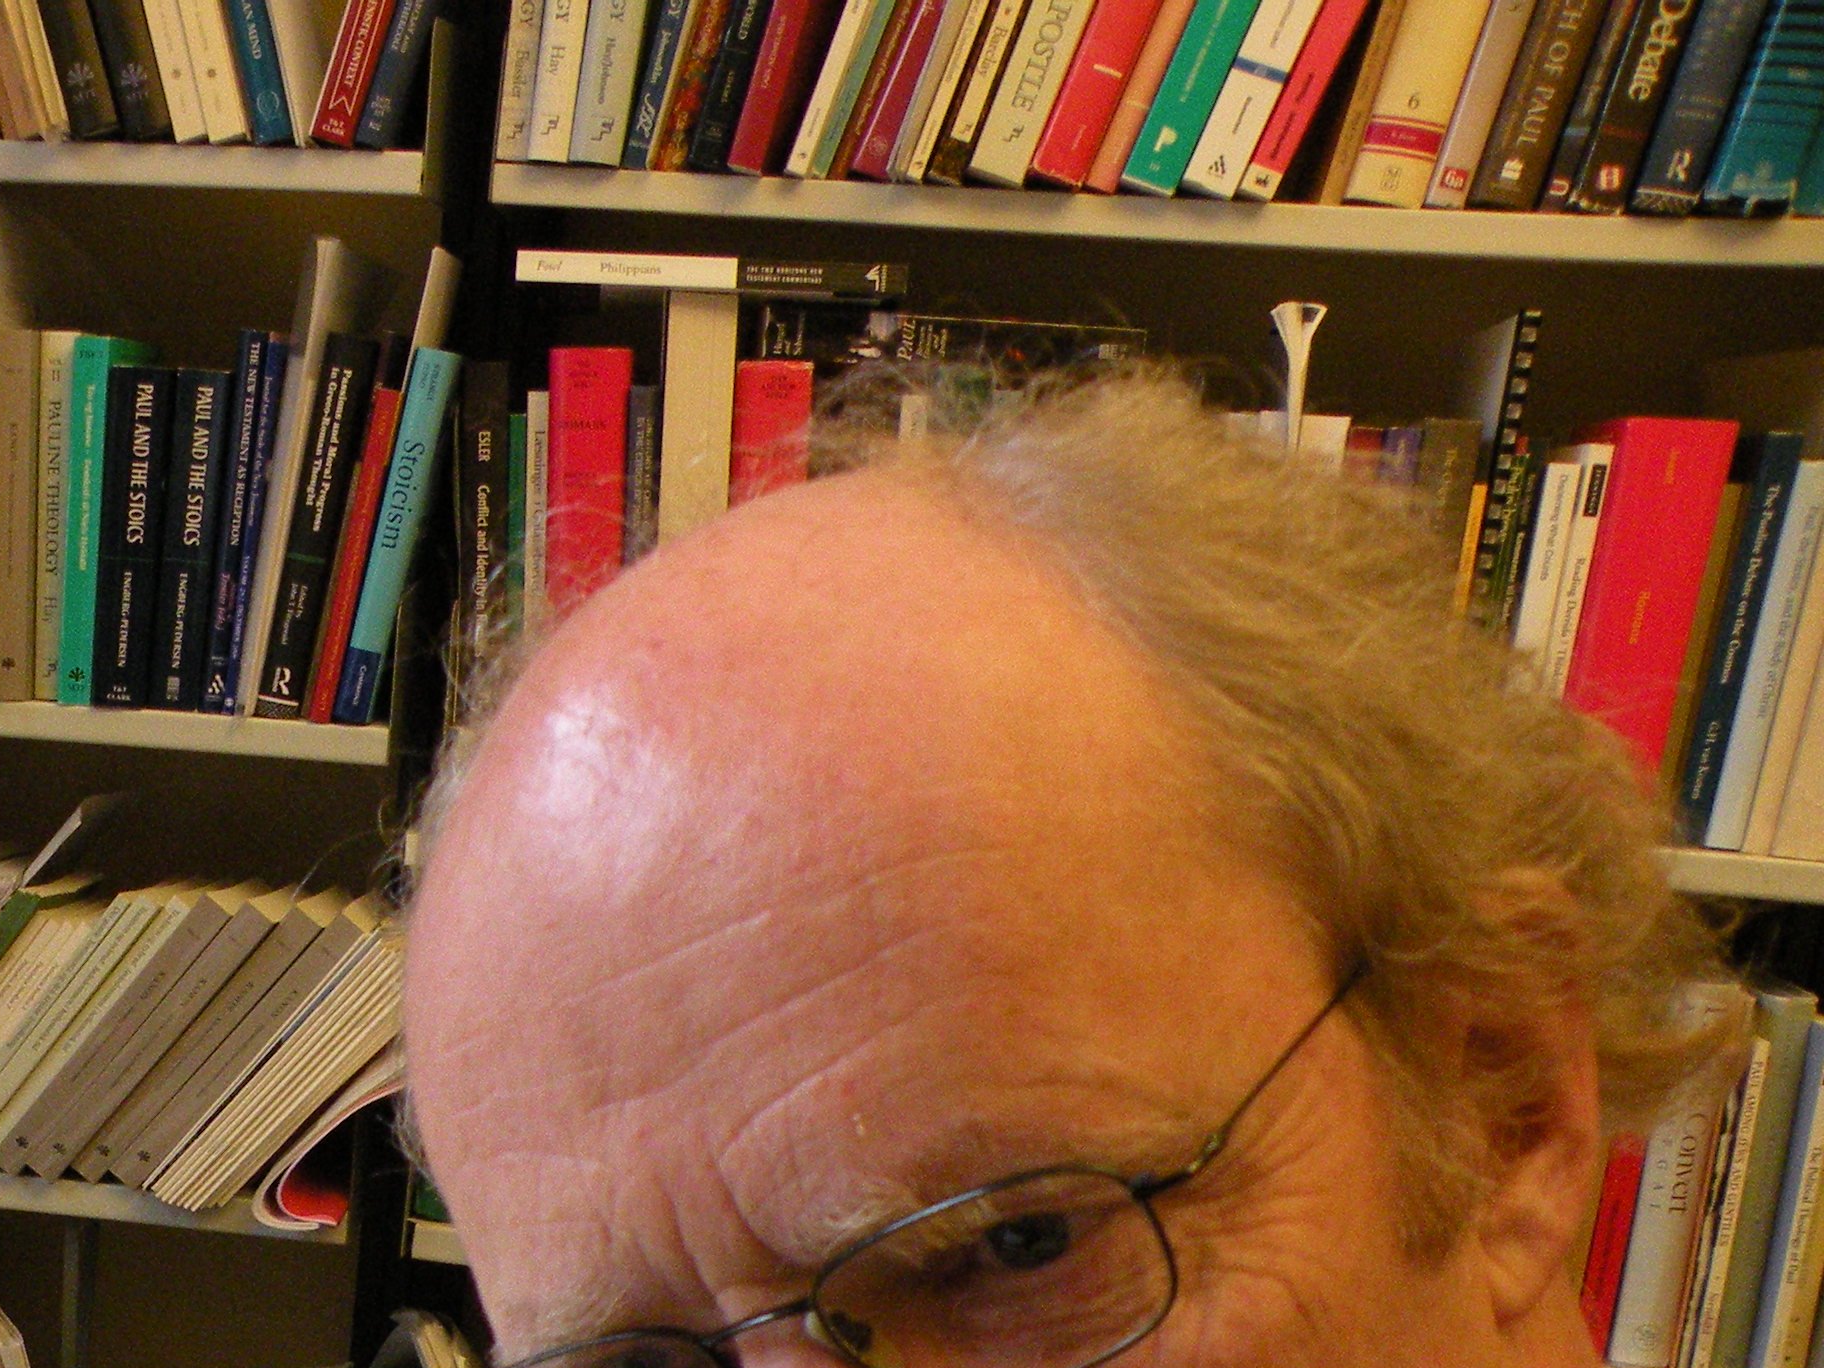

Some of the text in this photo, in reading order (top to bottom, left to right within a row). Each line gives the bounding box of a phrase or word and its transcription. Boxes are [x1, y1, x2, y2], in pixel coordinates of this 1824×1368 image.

[341, 39, 366, 87] CONTEXT
[511, 49, 529, 98] Bassler
[545, 44, 565, 76] Hay
[977, 26, 1009, 77] Barclay
[1514, 37, 1572, 153] OF PAUL
[536, 260, 661, 276] Fowl Philippians
[896, 319, 917, 361] PAUL
[126, 384, 155, 544] PAUL AND THE STOICS
[183, 386, 215, 546] PAUL AND THE STOICS
[228, 341, 260, 546] THE NEW TESTAMENT AS RECEPTION
[303, 367, 339, 506] in Greco-Roman Thought
[309, 368, 352, 532] Passions and Moral Progress
[42, 400, 62, 625] PAULINE THEOLOGY Hay
[380, 440, 426, 550] Stoicism
[473, 431, 490, 597] ESLER Conflict and Identity
[1538, 549, 1554, 582] Counts
[1560, 556, 1584, 638] Reading Derrida
[1627, 588, 1652, 646] Romans
[1716, 481, 1781, 686] The Pauline Debate the Cosmos
[1667, 1110, 1711, 1217] Convert
[1716, 1093, 1758, 1248] AMONG AND GENTILES
[1789, 1206, 1809, 1250] Theology
